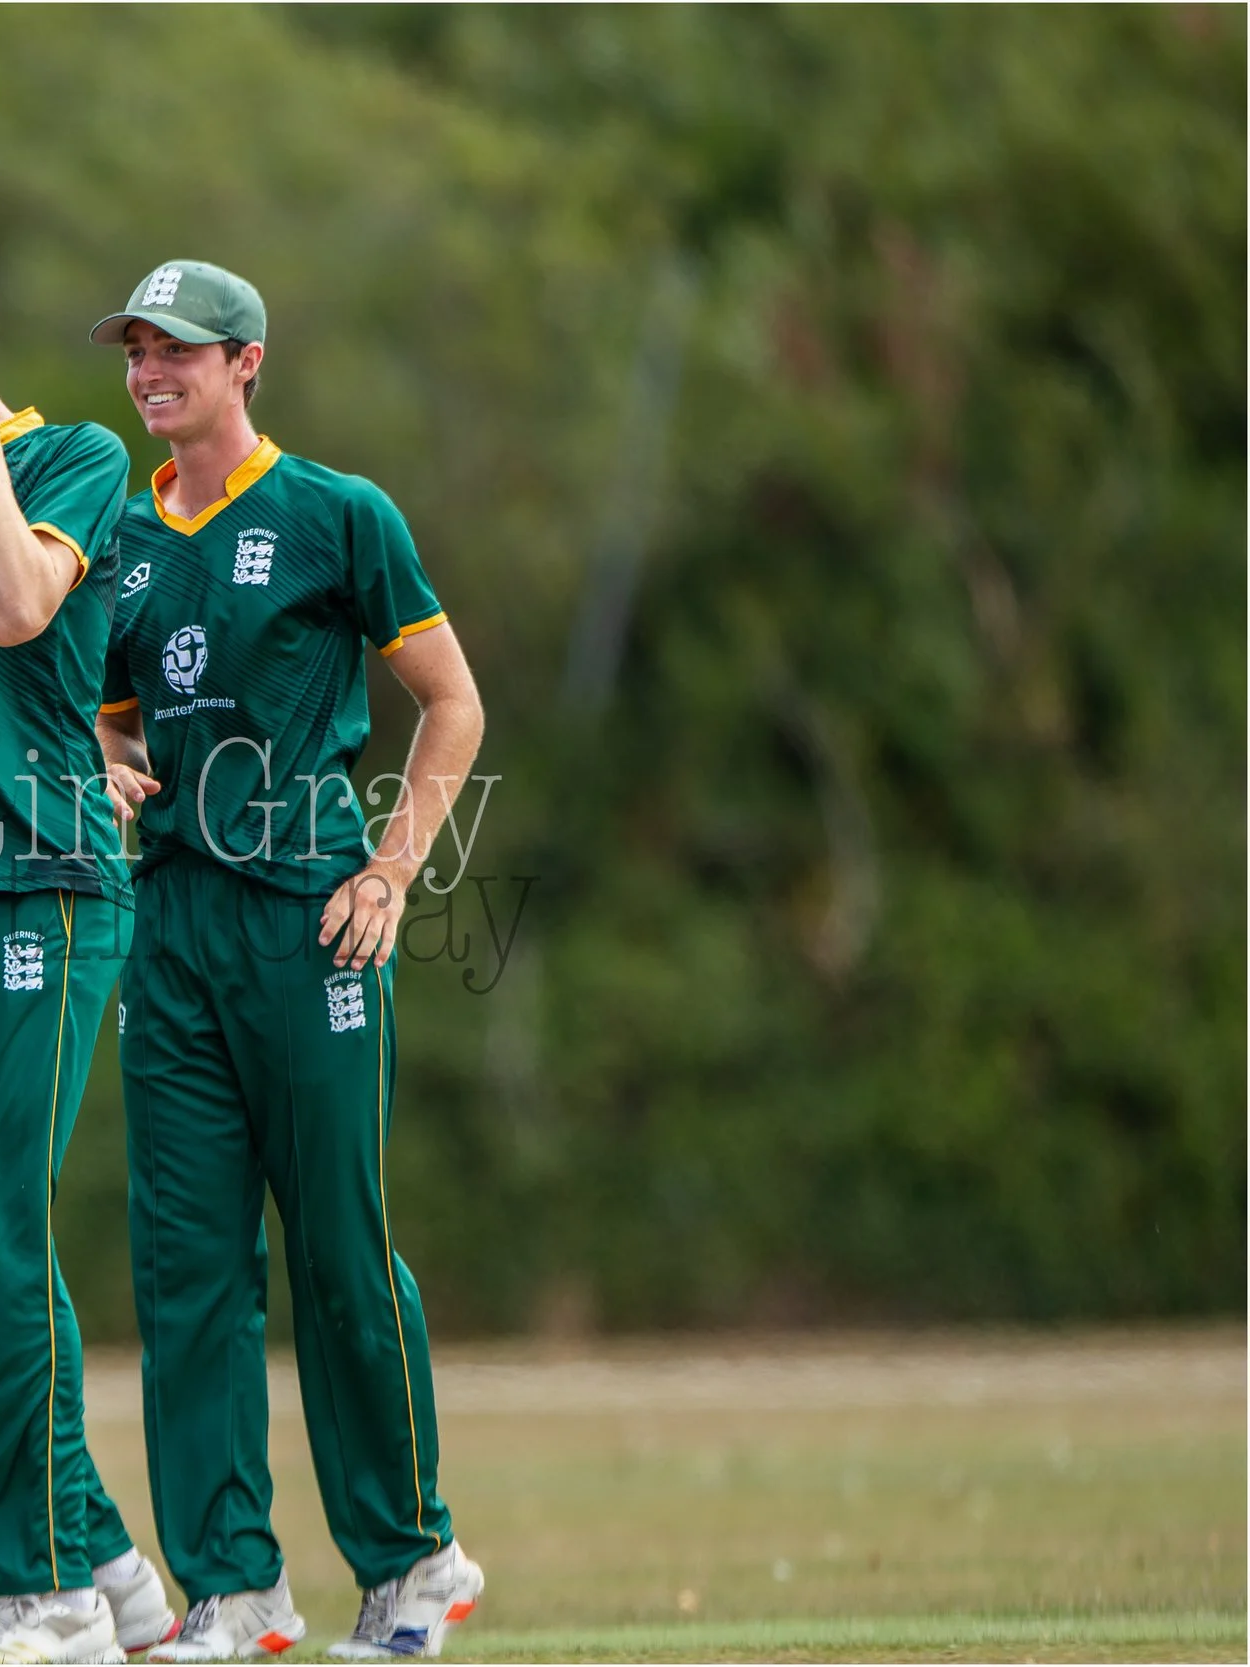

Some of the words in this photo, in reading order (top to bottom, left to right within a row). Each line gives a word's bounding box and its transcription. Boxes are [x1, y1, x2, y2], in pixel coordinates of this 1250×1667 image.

[237, 527, 280, 541] GUERNSEY
[3, 930, 45, 943] GUERNSEY
[323, 969, 363, 987] GUERNSEY
